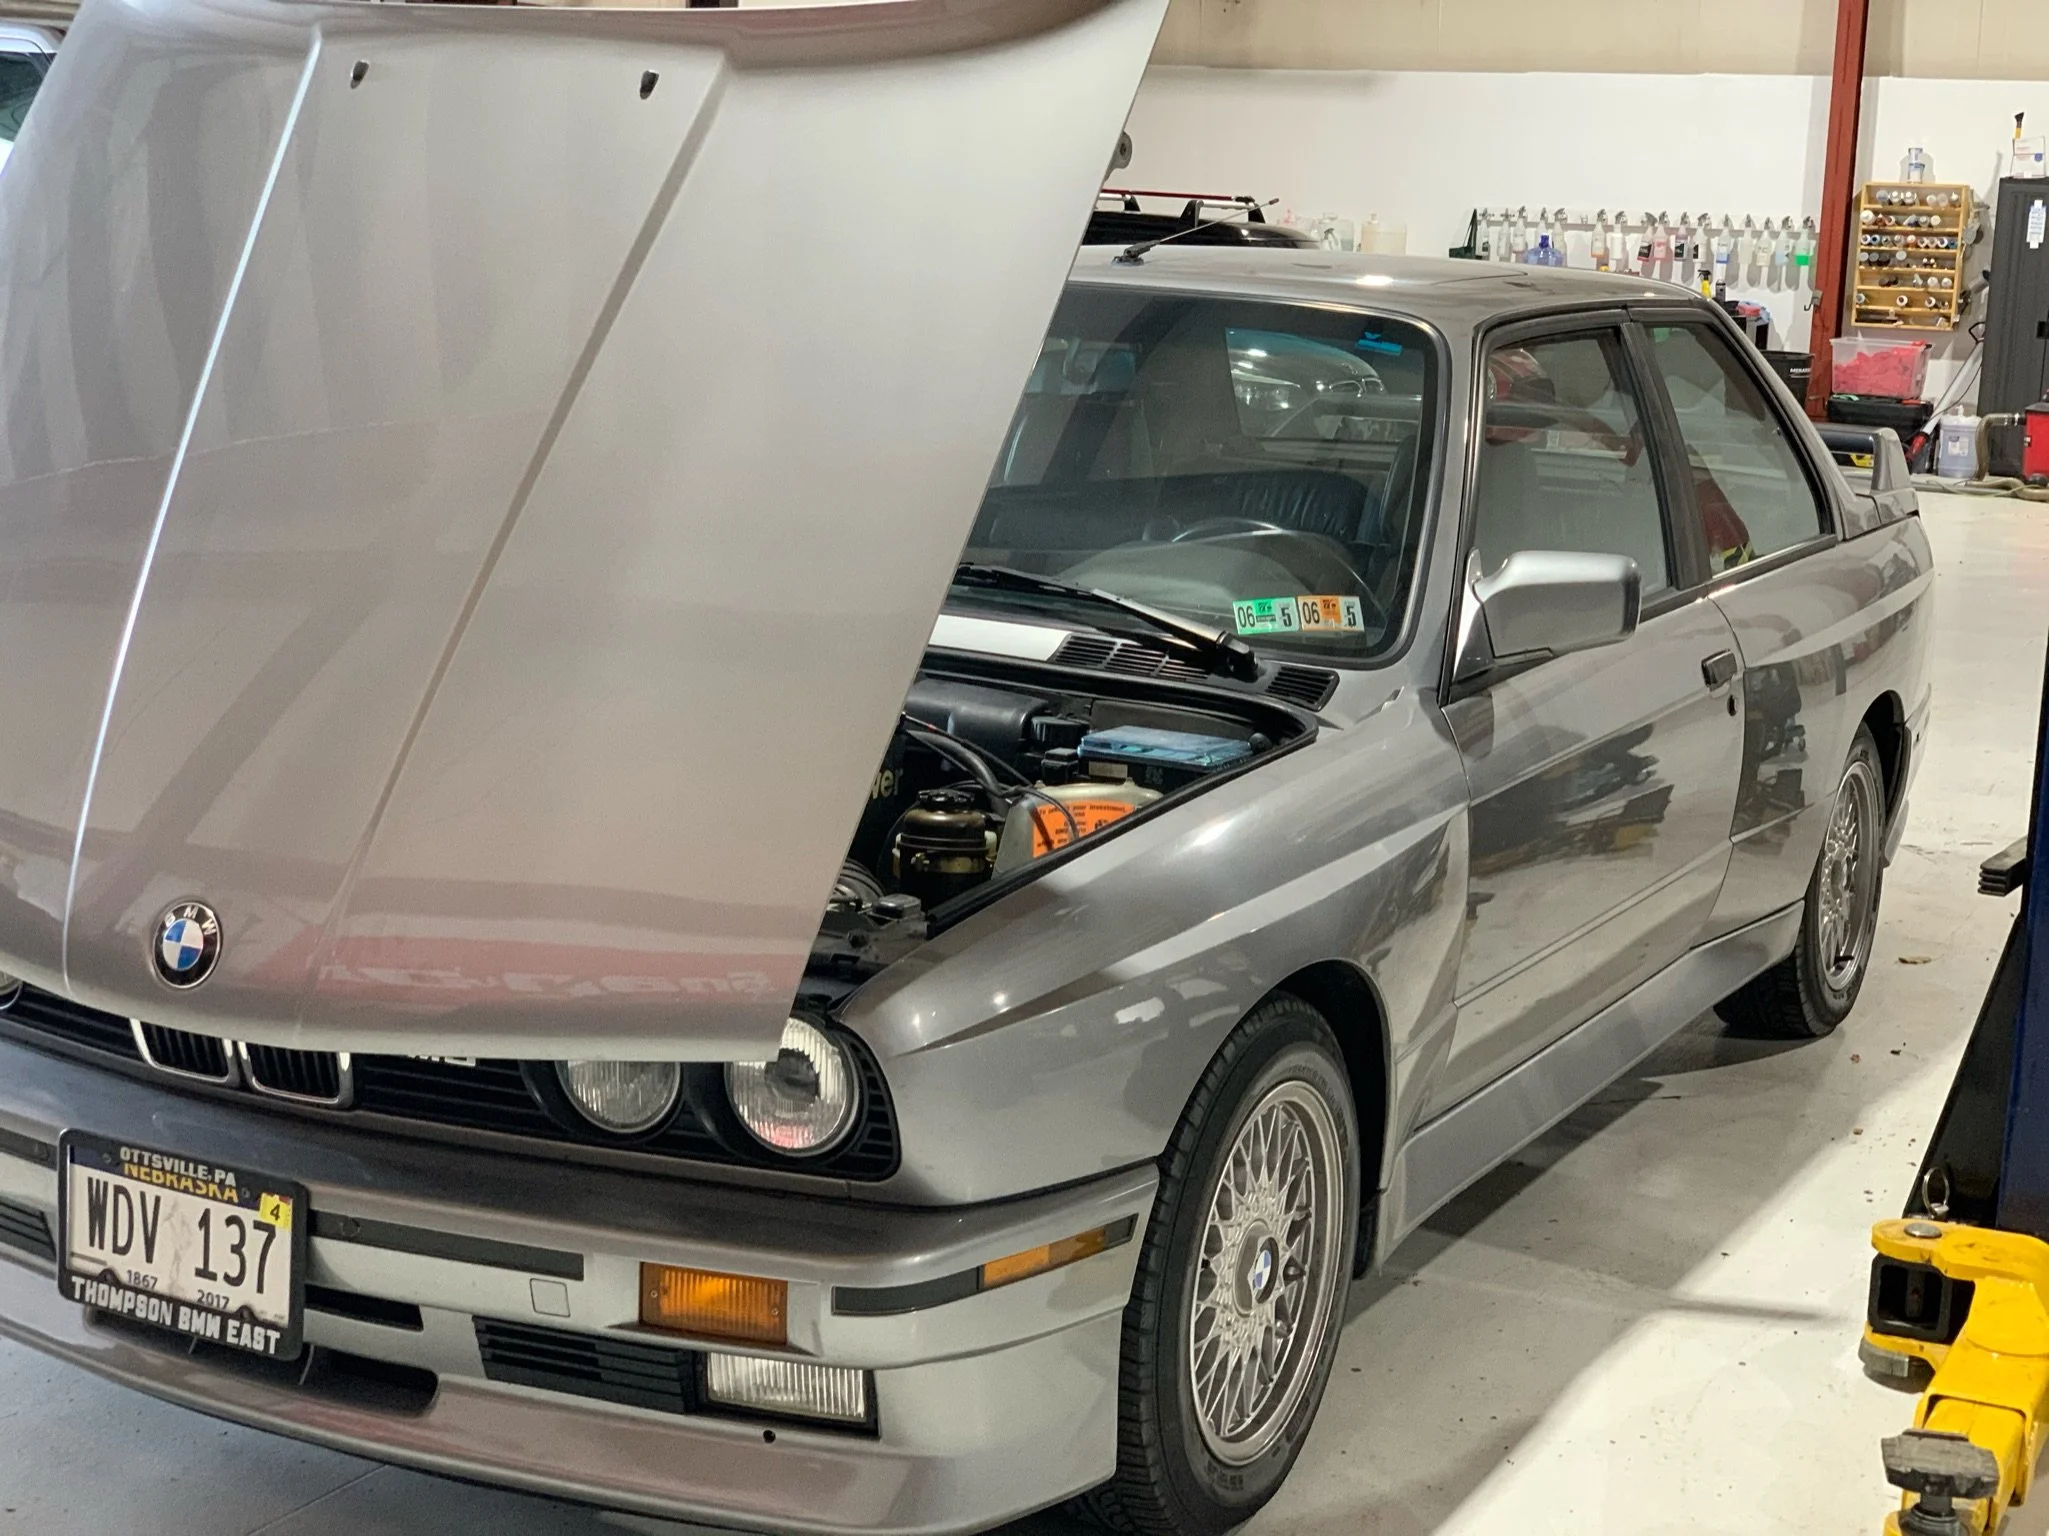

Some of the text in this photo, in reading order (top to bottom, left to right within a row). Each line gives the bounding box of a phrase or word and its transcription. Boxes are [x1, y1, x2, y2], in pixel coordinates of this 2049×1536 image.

[1237, 605, 1256, 628] 06
[1281, 606, 1292, 627] 5
[1302, 601, 1320, 625] 06
[1346, 605, 1357, 627] 5
[164, 905, 217, 936] BMW
[120, 1146, 237, 1188] OTTSVILLE, PA
[124, 1163, 239, 1203] NEBRASKA
[270, 1203, 281, 1221] 4
[87, 1176, 277, 1295] WDV 137
[126, 1270, 230, 1310] 1867 2017
[71, 1276, 281, 1355] THOMPSON BMW EAST
